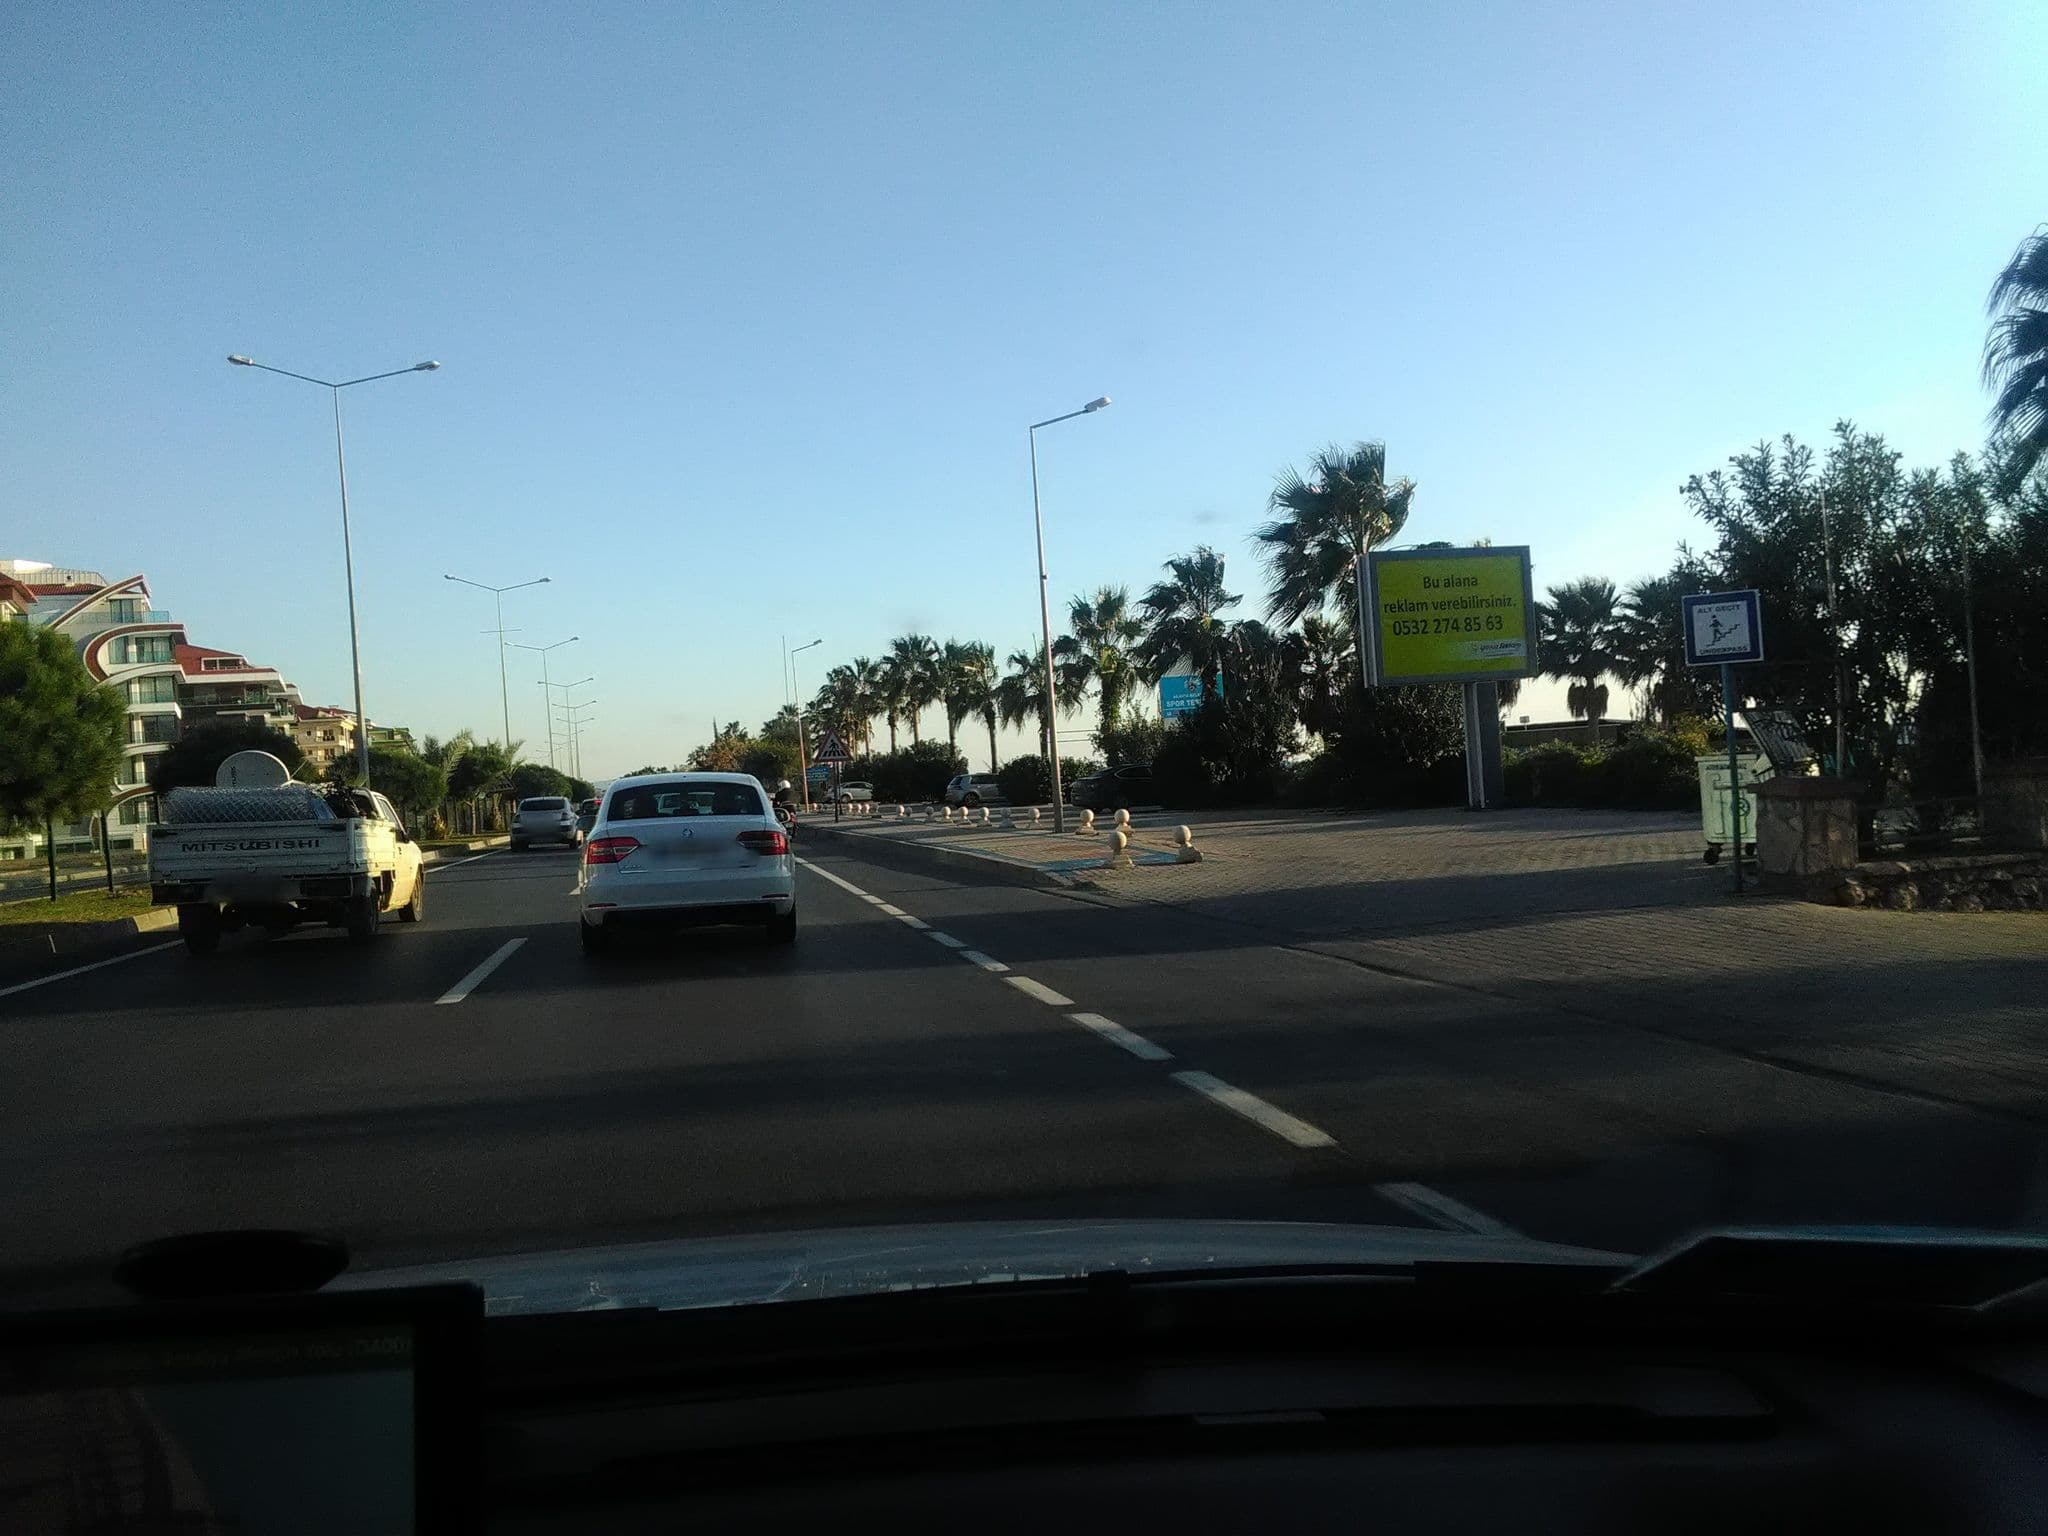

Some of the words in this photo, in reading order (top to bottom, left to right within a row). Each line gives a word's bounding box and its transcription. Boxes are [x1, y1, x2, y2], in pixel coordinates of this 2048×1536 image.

[1423, 576, 1440, 589] Bu
[1444, 575, 1478, 588] alana
[1384, 597, 1429, 613] reklam
[1432, 594, 1517, 611] verebilirsiniz.
[1392, 619, 1428, 636] 0532
[1433, 617, 1460, 634] 274
[1464, 616, 1481, 632] 85
[1486, 615, 1504, 631] 63
[1166, 700, 1185, 708] SPOR
[181, 839, 320, 852] MITSUBISHI
